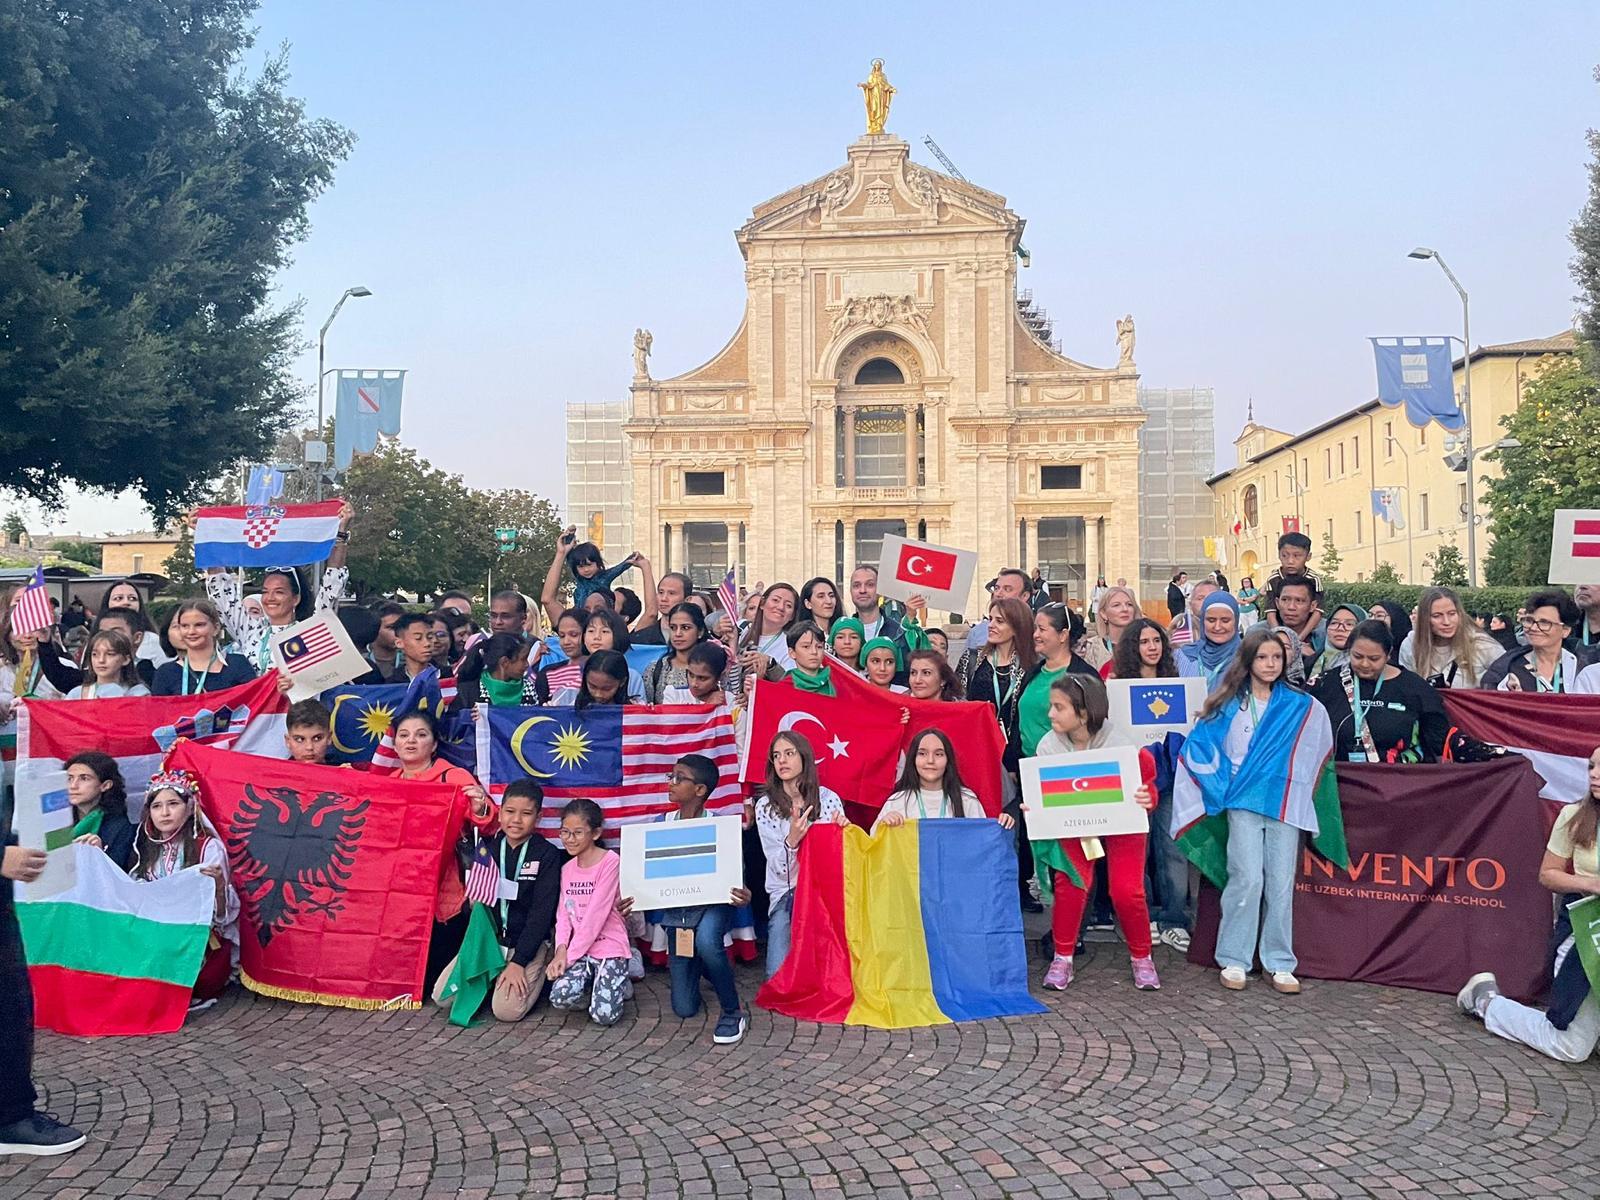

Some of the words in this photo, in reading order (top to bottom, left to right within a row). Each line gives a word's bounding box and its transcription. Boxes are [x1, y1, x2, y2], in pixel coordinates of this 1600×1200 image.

[1063, 818, 1108, 827] AZERBAIJAN
[1303, 847, 1506, 891] NVENTO
[659, 886, 702, 897] BOTSWANA
[1295, 882, 1312, 892] HE
[1314, 884, 1354, 897] UZBEK
[1356, 888, 1450, 903] INTERNATIONAL
[1453, 894, 1506, 909] SCHOOL
